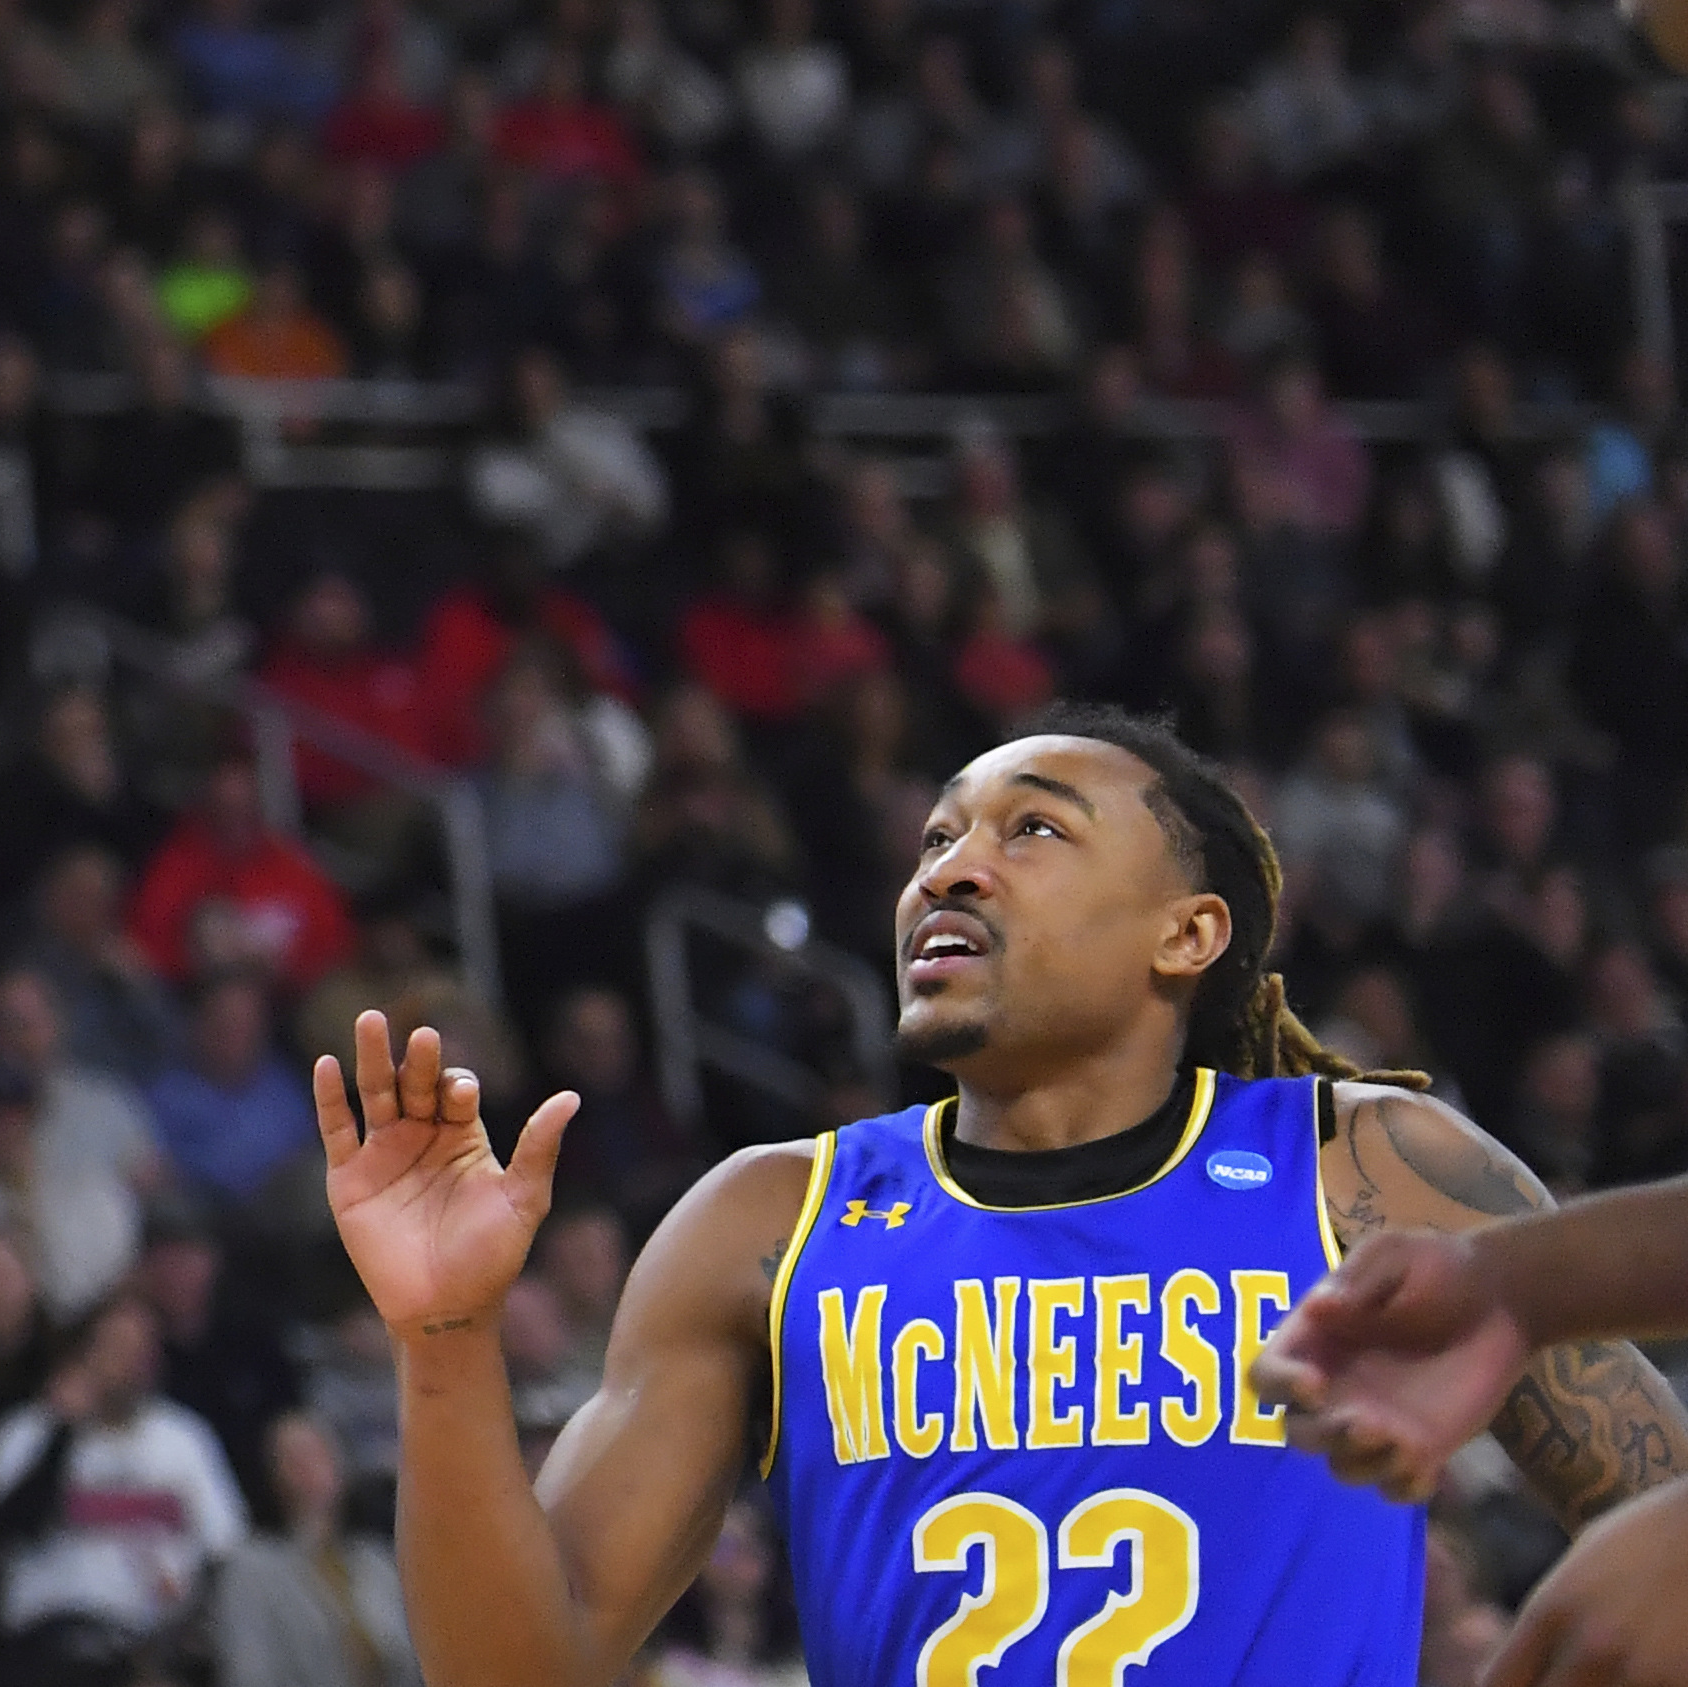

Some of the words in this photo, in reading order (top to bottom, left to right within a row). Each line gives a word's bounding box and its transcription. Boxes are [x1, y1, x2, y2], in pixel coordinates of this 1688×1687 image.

[1213, 1164, 1268, 1182] NCAA
[818, 1268, 1291, 1465] McNEESE
[912, 1487, 1200, 1687] 22
